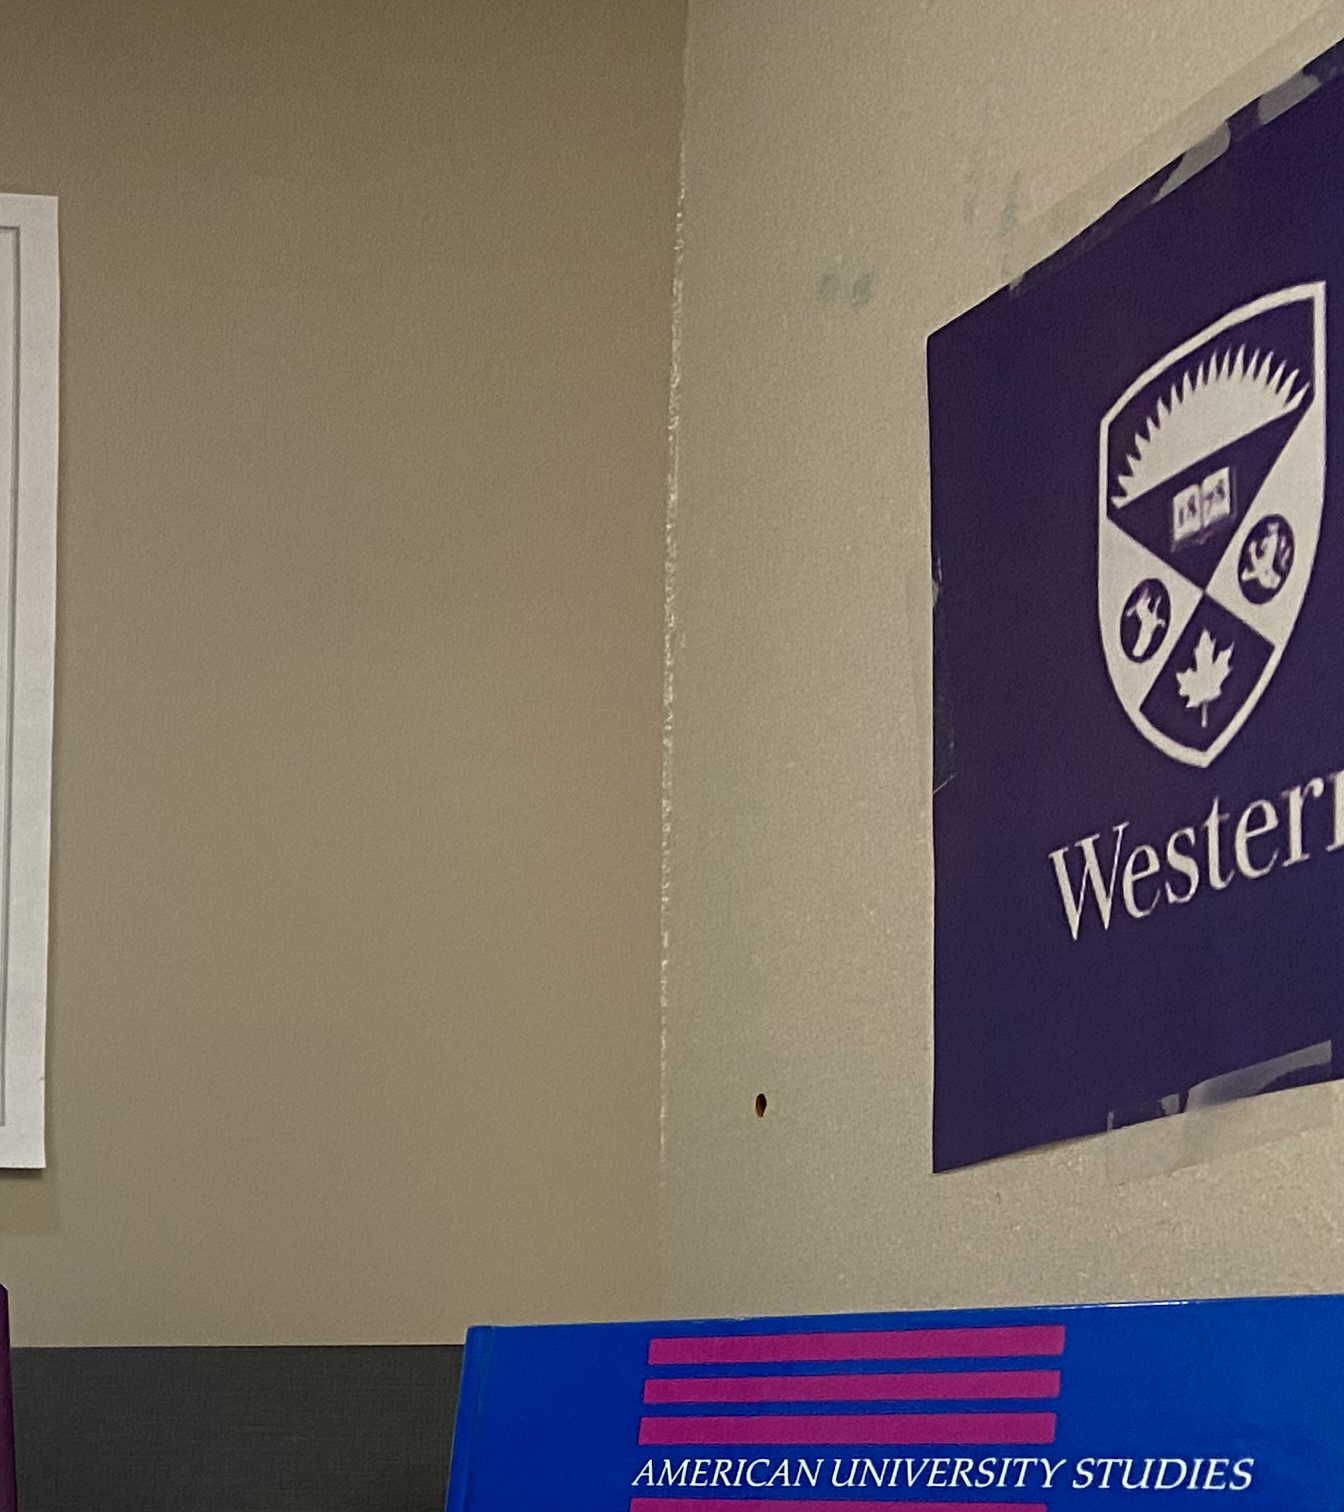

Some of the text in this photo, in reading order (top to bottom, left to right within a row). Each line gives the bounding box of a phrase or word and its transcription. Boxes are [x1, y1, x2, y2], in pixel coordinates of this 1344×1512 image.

[630, 1458, 1255, 1491] AMERICAN UNIVERSITY STUDIES
